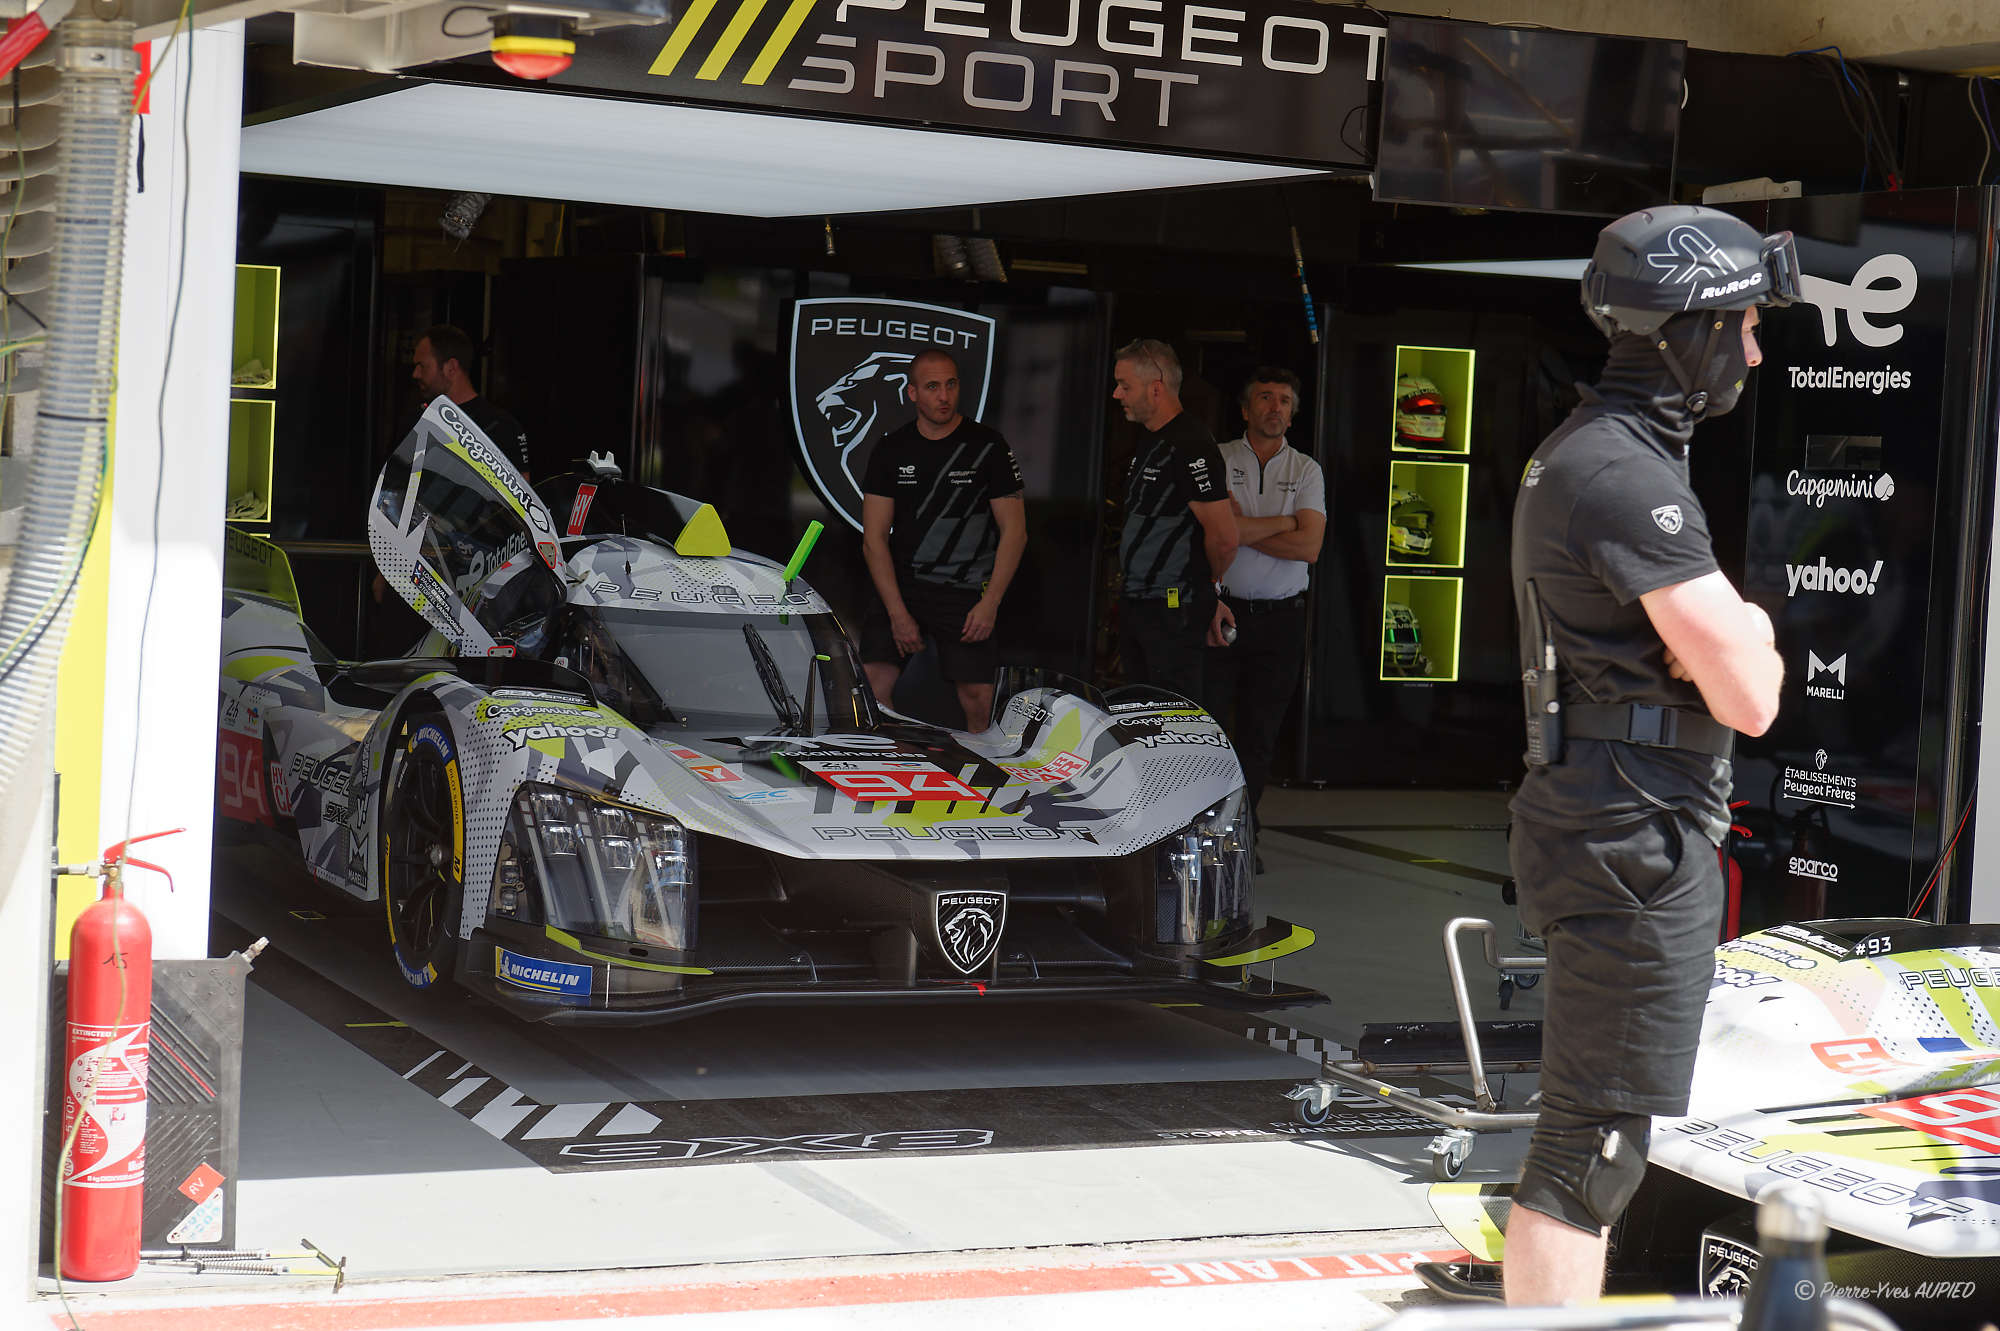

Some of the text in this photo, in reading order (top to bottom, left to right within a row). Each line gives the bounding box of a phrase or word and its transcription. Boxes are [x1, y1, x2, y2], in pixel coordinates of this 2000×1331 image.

[788, 33, 1199, 127] SPORT
[811, 318, 977, 349] PEUGEOT
[1788, 366, 1912, 395] TotalEnergies
[439, 404, 533, 511] Capgemini
[1787, 469, 1873, 508] Capgemini
[228, 528, 275, 568] EUGEOT
[1786, 556, 1884, 597] yahoo!
[1806, 685, 1845, 701] MARELLI
[486, 705, 581, 718] Capgemini
[1119, 714, 1199, 726] Capgemini
[503, 723, 618, 750] yahoo!
[1134, 731, 1230, 749] yahoo!
[222, 743, 266, 817] 94
[829, 774, 977, 797] 94
[1785, 766, 1857, 788] ÉTABLISSEMENTS
[1784, 779, 1856, 801] Peugeot Frères
[812, 826, 1094, 841] PEUGEOT
[1789, 856, 1838, 878] sparco
[941, 897, 1000, 906] PEUGEOT
[1856, 936, 1892, 956] #93
[511, 963, 580, 986] MICHELIN
[1157, 1129, 1277, 1140] STOFFEL
[1660, 1118, 1973, 1218] PEUGEOT
[1708, 1245, 1759, 1271] PEUGEO
